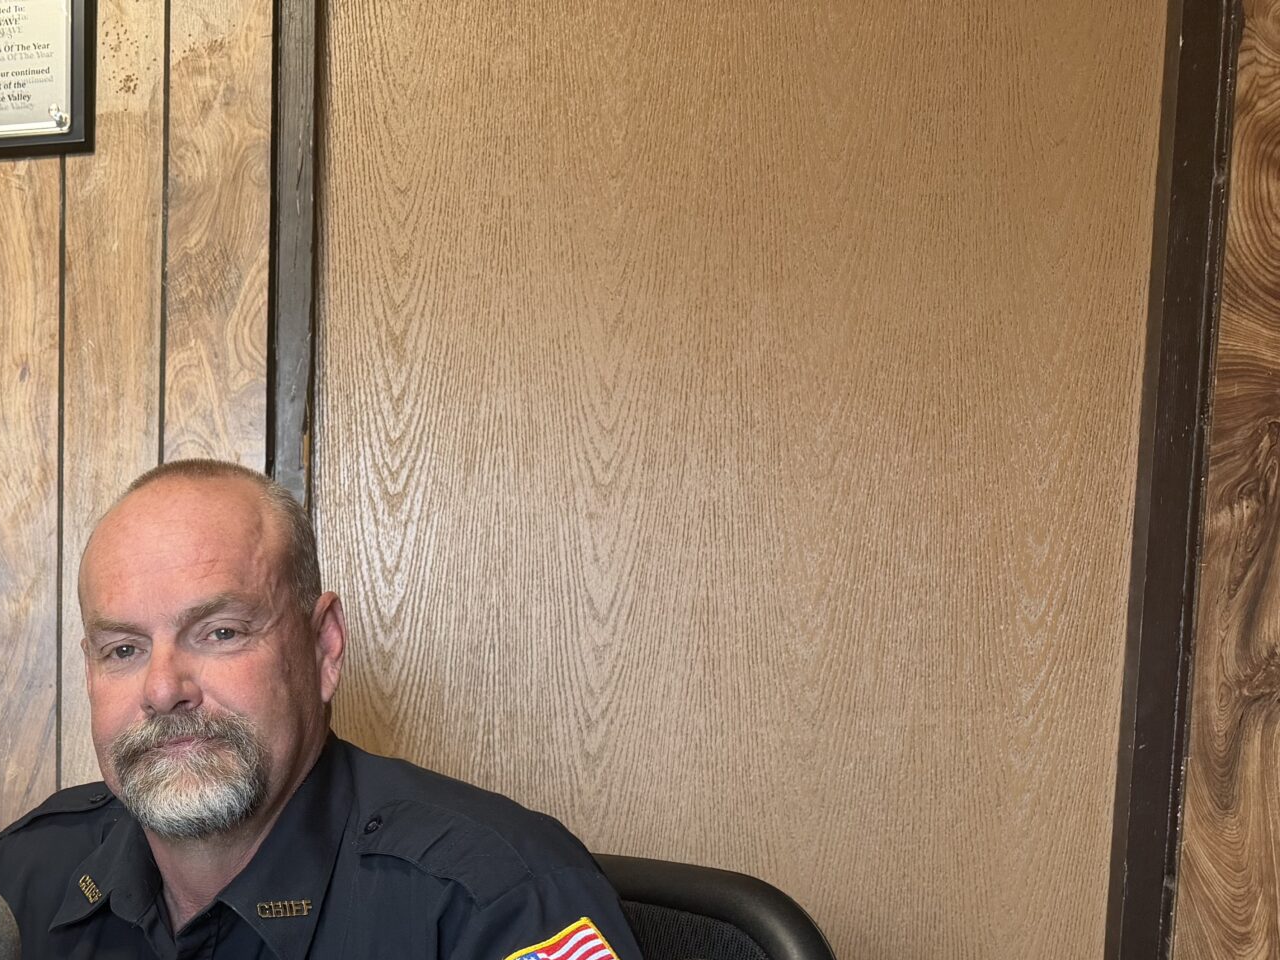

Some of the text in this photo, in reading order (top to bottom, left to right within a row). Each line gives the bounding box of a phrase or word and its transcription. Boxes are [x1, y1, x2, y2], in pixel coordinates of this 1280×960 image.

[4, 44, 14, 53] Of
[16, 43, 30, 52] The
[32, 42, 50, 51] Year
[11, 66, 50, 77] continued
[4, 82, 12, 90] of
[14, 80, 26, 90] the
[8, 93, 32, 104] Valley
[78, 874, 102, 904] CHIEF
[256, 900, 312, 918] CHIEF
